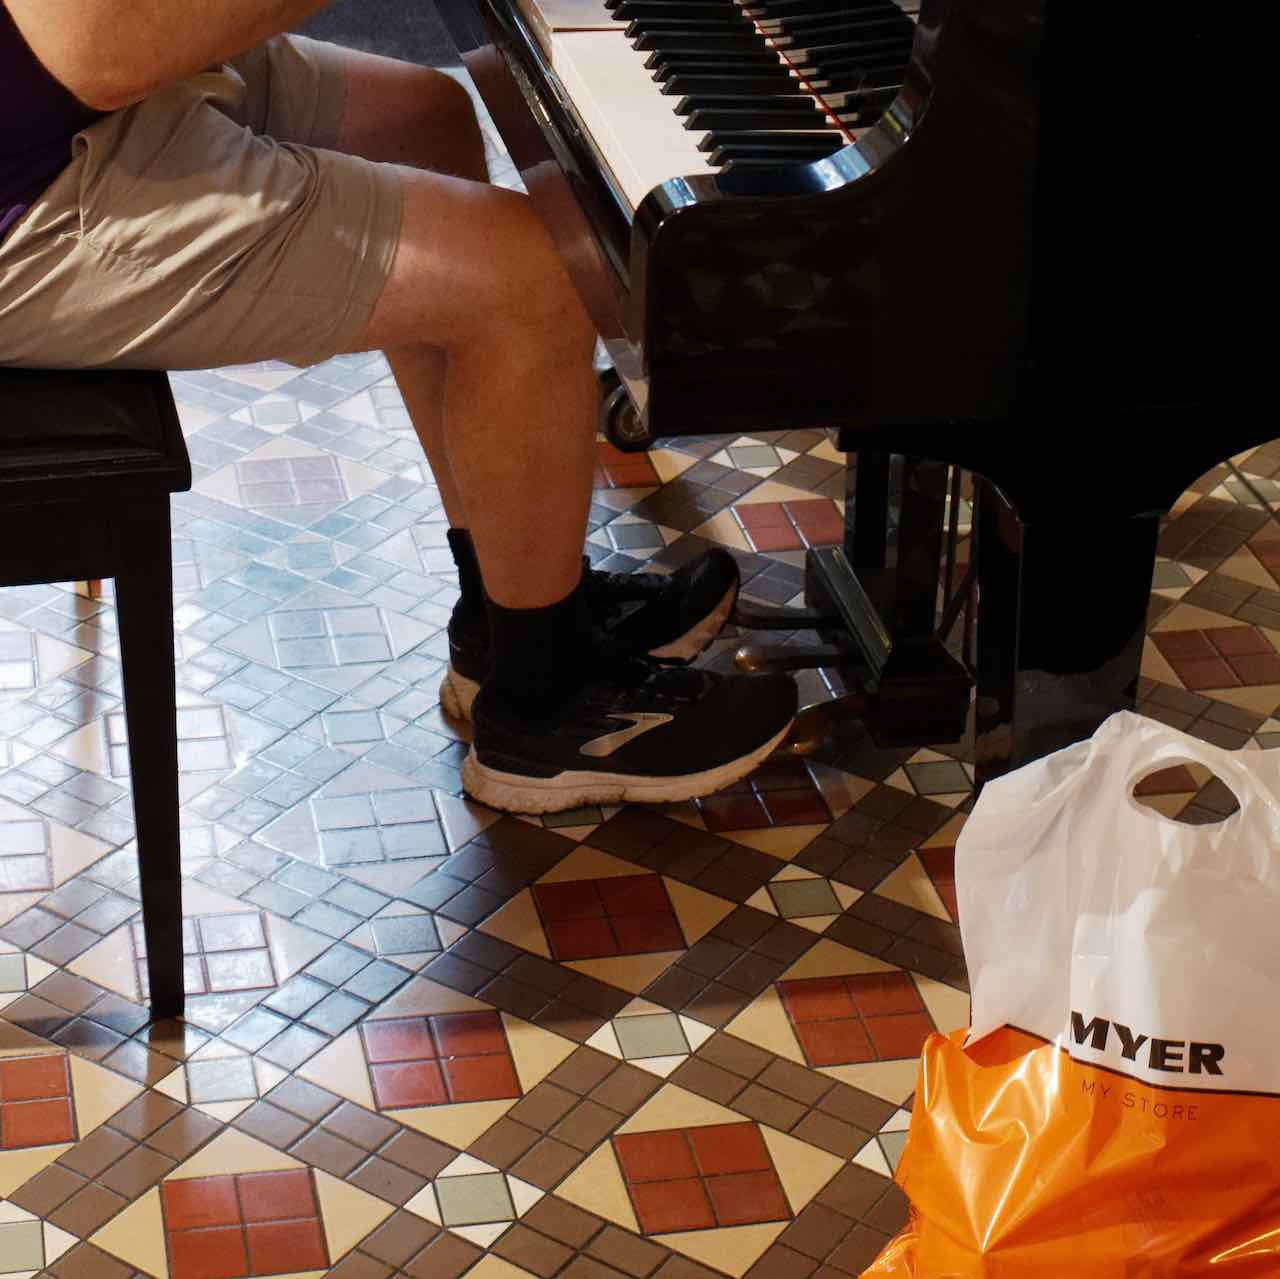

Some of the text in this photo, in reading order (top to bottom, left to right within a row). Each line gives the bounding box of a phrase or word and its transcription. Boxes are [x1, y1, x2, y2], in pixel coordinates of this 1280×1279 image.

[1070, 1010, 1225, 1076] MYER
[1081, 1079, 1199, 1121] MY STORE
